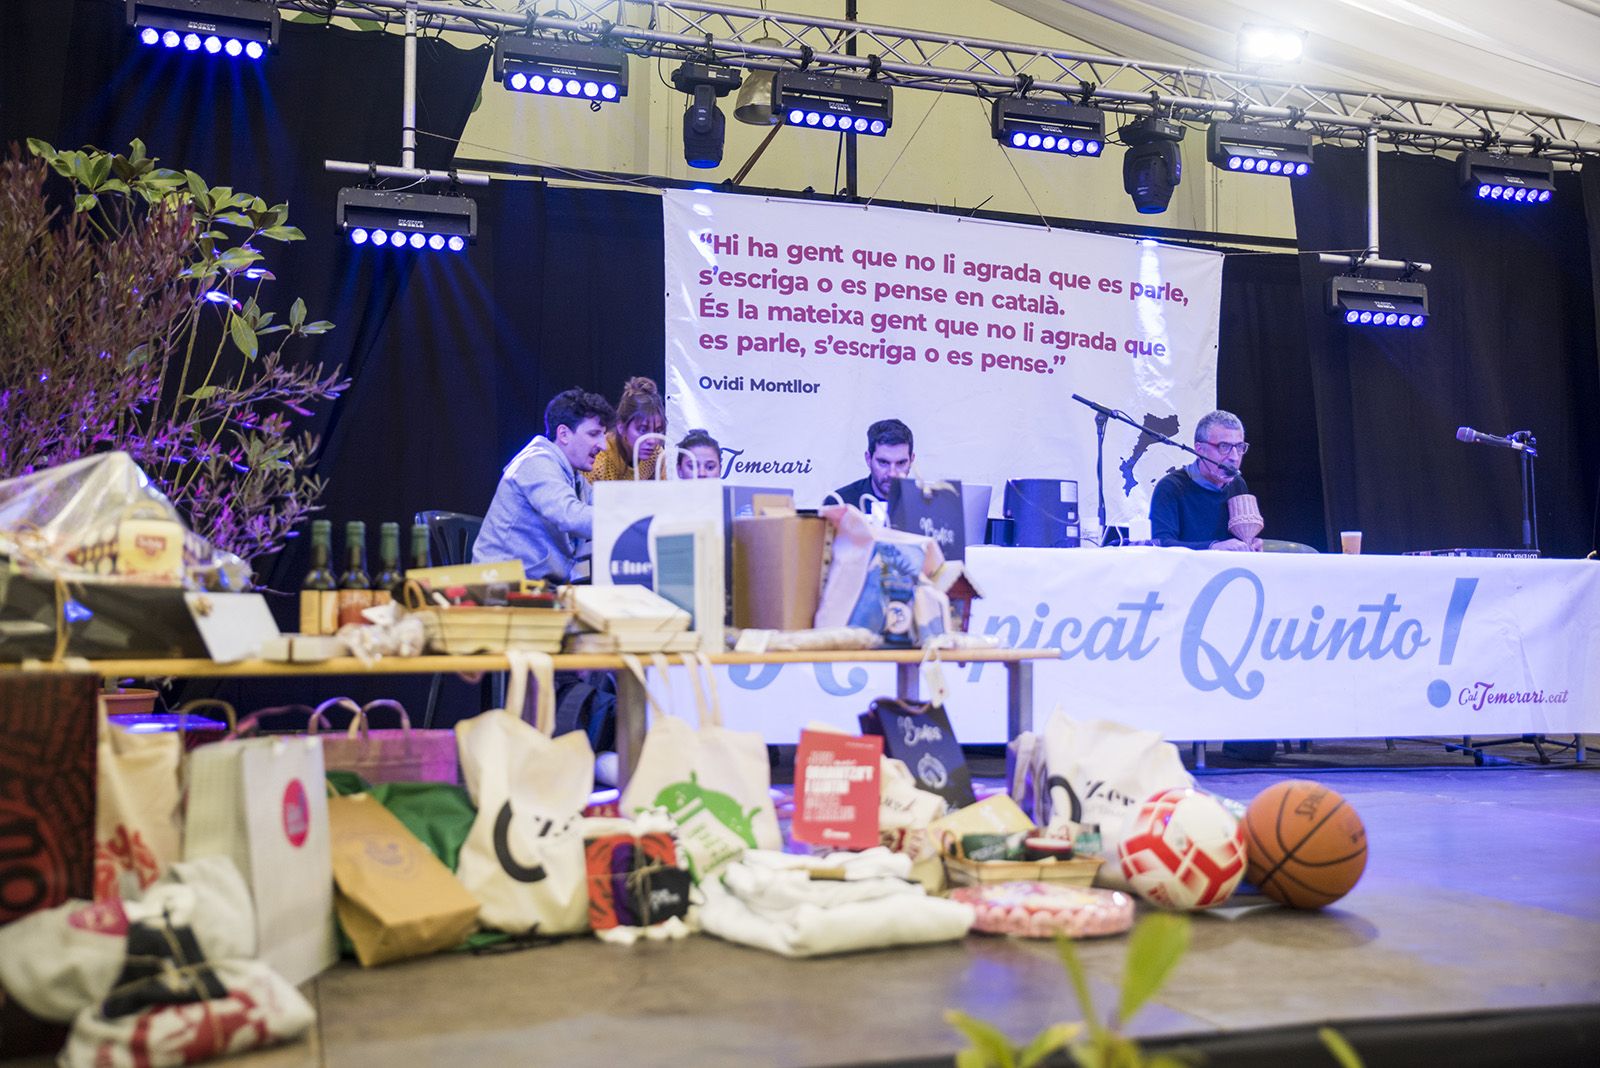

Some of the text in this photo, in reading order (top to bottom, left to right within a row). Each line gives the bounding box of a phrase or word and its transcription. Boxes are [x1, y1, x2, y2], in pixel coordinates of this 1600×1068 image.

[748, 235, 779, 258] ha
[787, 242, 844, 265] gent
[852, 249, 897, 270] que
[905, 254, 935, 272] no
[943, 253, 956, 274] li
[963, 260, 1042, 285] agrada
[1049, 270, 1091, 292] que
[1098, 277, 1123, 294] es
[1130, 280, 1189, 306] parle,
[817, 277, 833, 293] o
[840, 279, 867, 295] es
[874, 281, 948, 305] pense
[955, 289, 985, 307] en
[991, 292, 1066, 317] català.
[699, 292, 1167, 360] És la mateixa gent que no li agrada que
[699, 333, 729, 350] es
[737, 332, 807, 359] parle,
[923, 348, 939, 363] o
[947, 349, 973, 367] es
[699, 375, 821, 395] Ovidi Montllor
[720, 447, 813, 480] Temerari
[967, 567, 1479, 708] picat Quinto!
